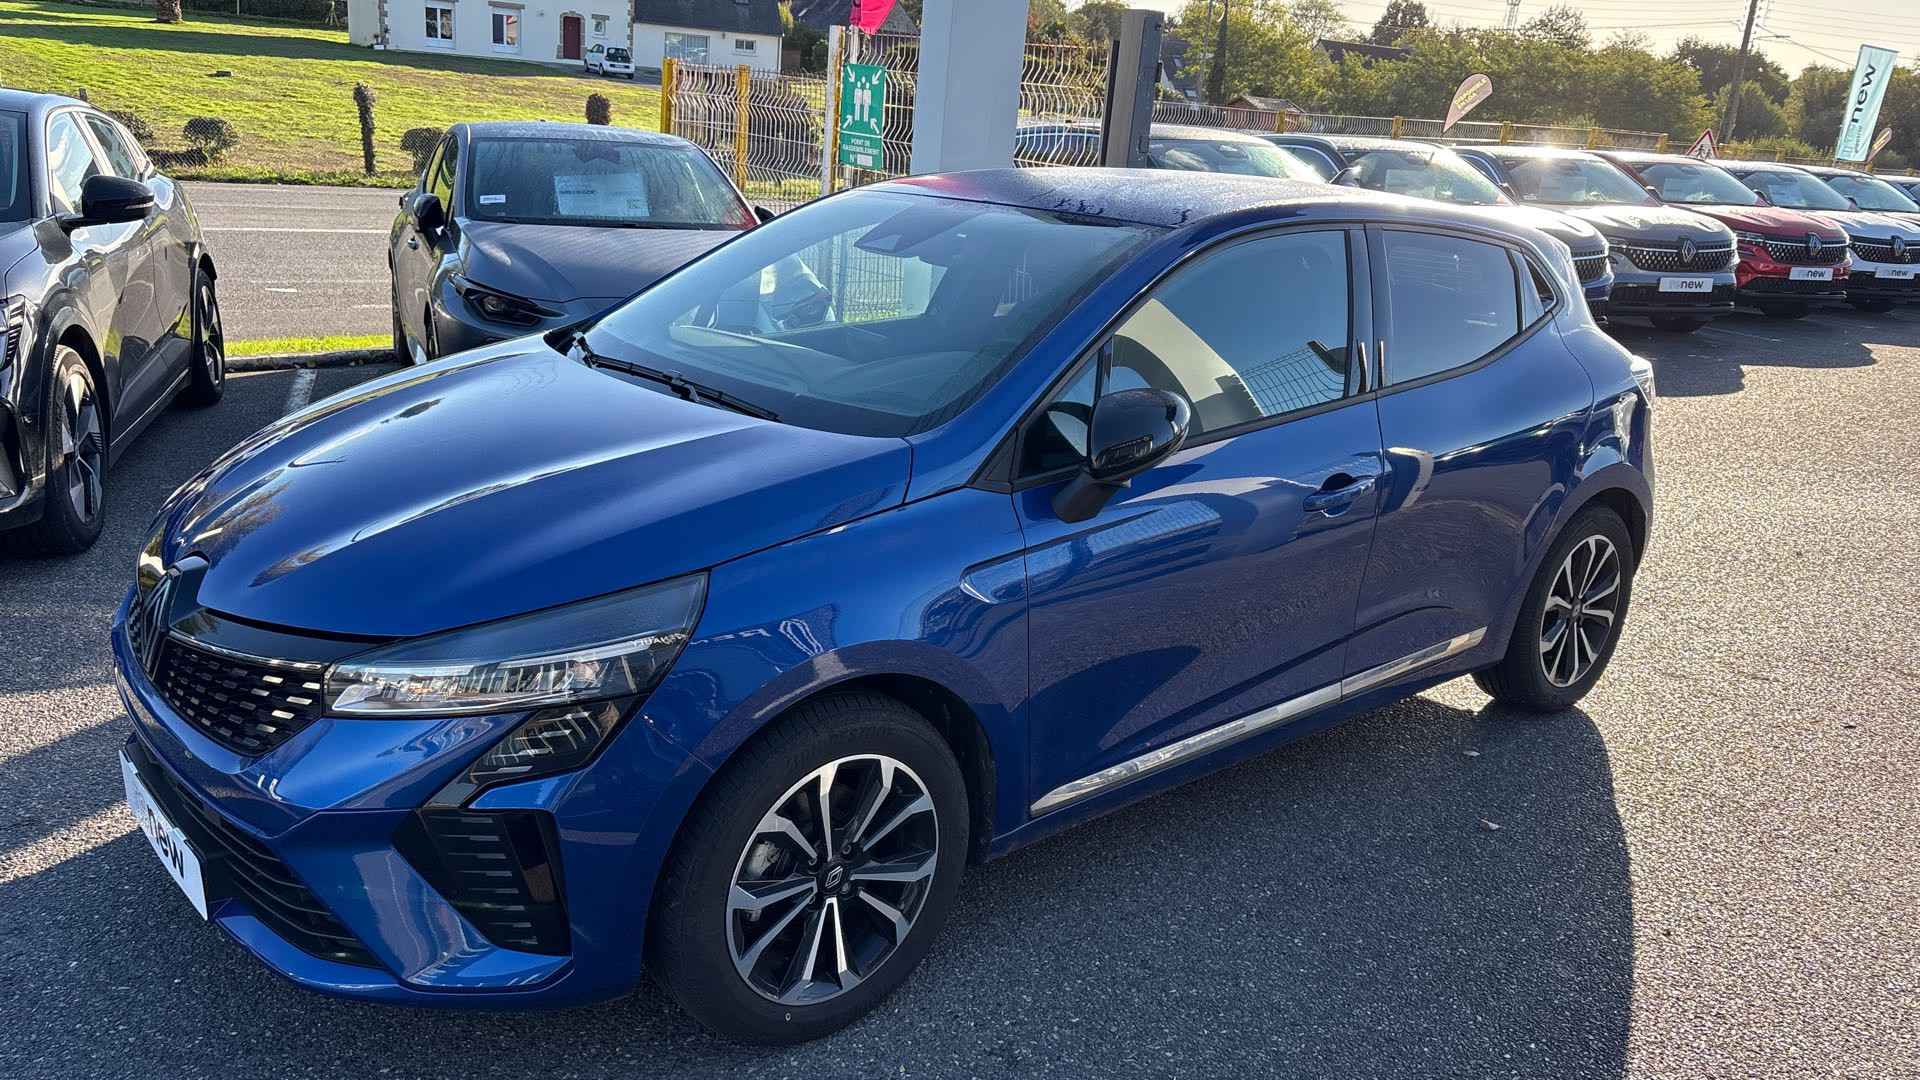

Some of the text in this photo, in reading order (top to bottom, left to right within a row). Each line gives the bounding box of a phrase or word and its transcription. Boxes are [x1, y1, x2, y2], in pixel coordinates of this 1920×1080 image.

[851, 138, 870, 147] POINT DE
[842, 144, 879, 154] RASSEMBLEMENT
